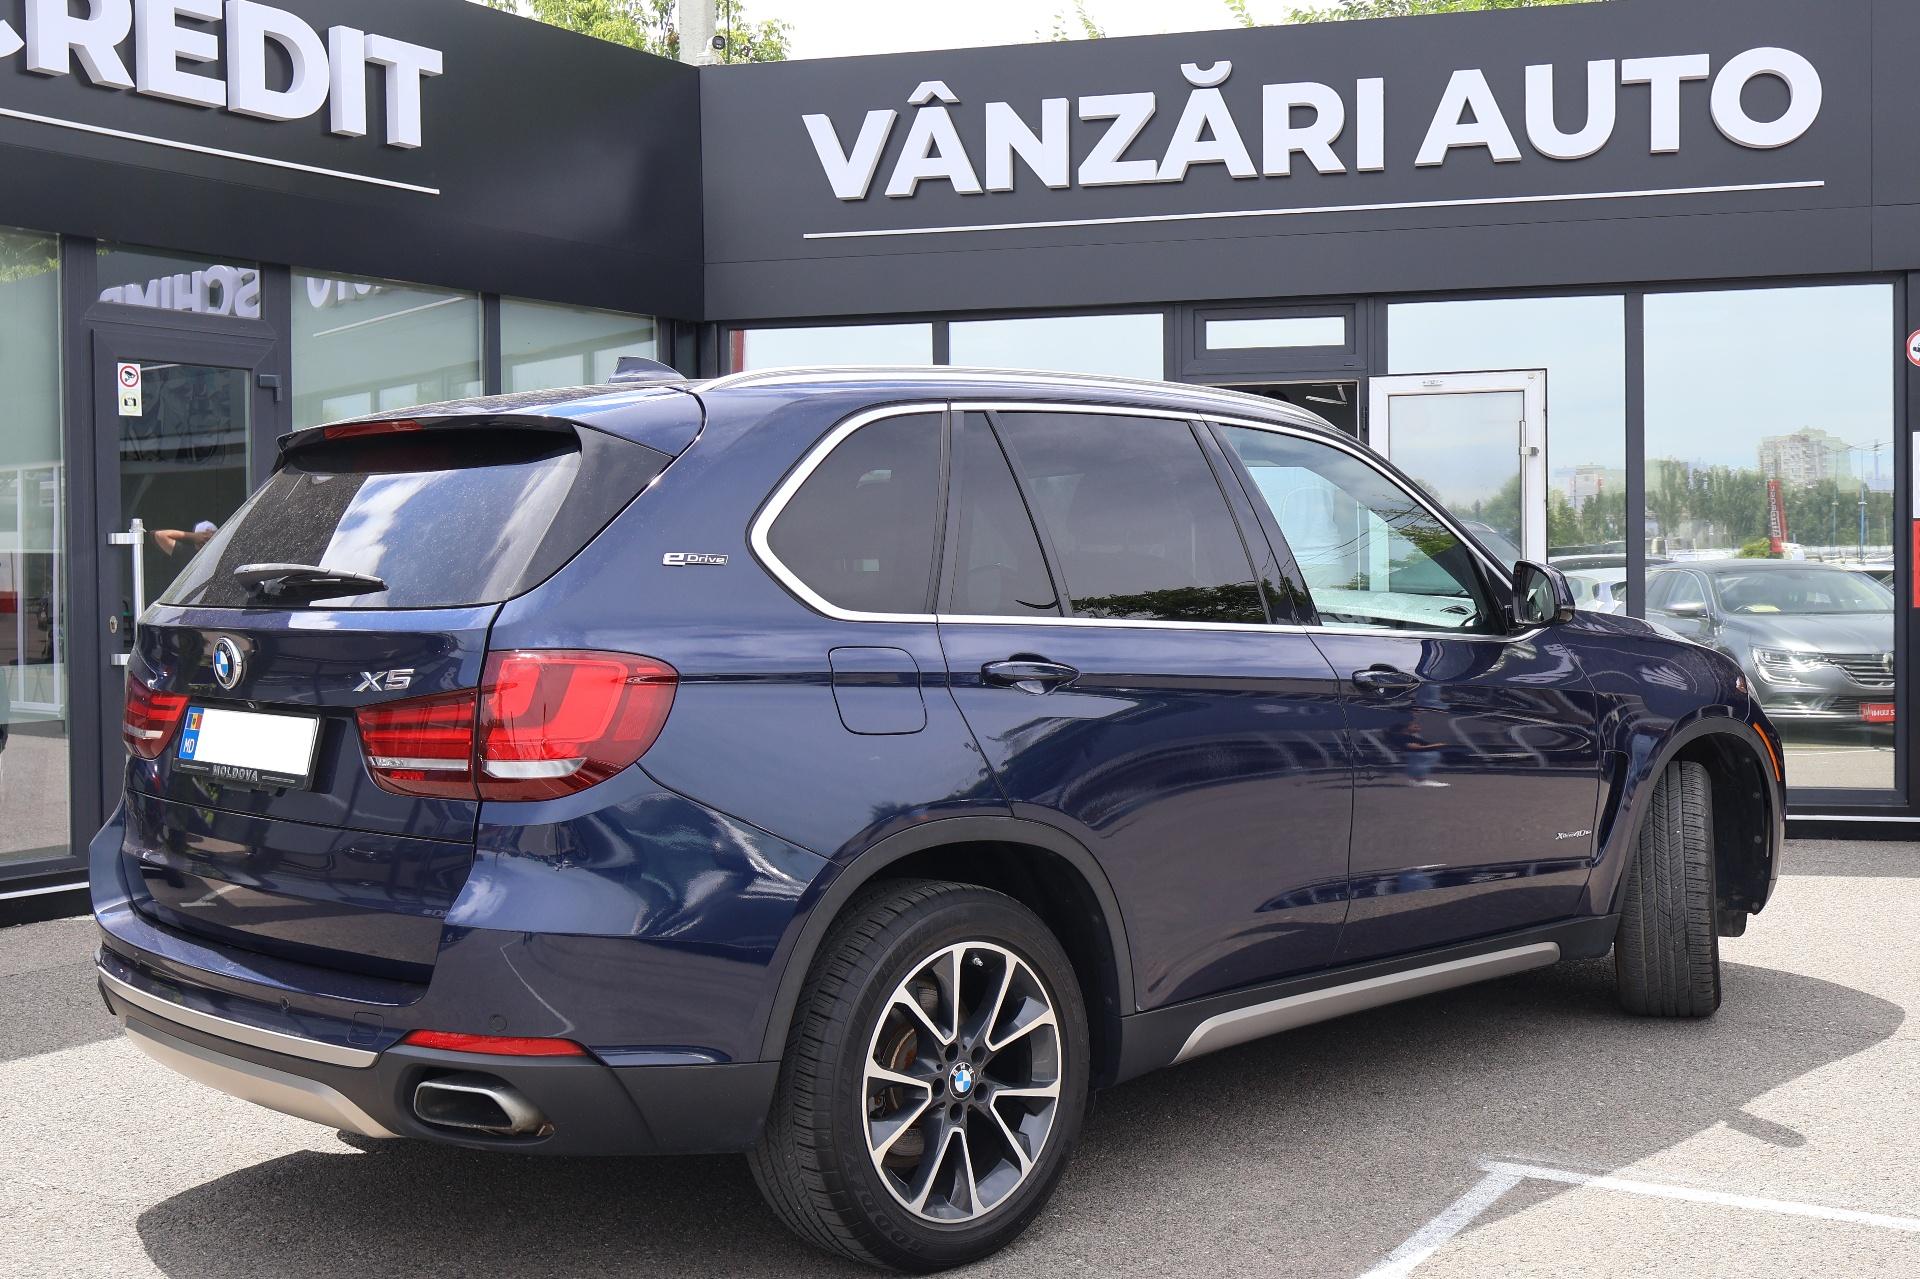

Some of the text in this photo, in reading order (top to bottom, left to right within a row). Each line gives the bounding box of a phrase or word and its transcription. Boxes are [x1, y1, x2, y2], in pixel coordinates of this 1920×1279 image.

[0, 0, 443, 149] REDIT
[801, 46, 1823, 200] VÂNZĂRI AUTO
[352, 668, 415, 692] X5
[183, 738, 195, 754] MD
[212, 764, 258, 782] MOLDOVA
